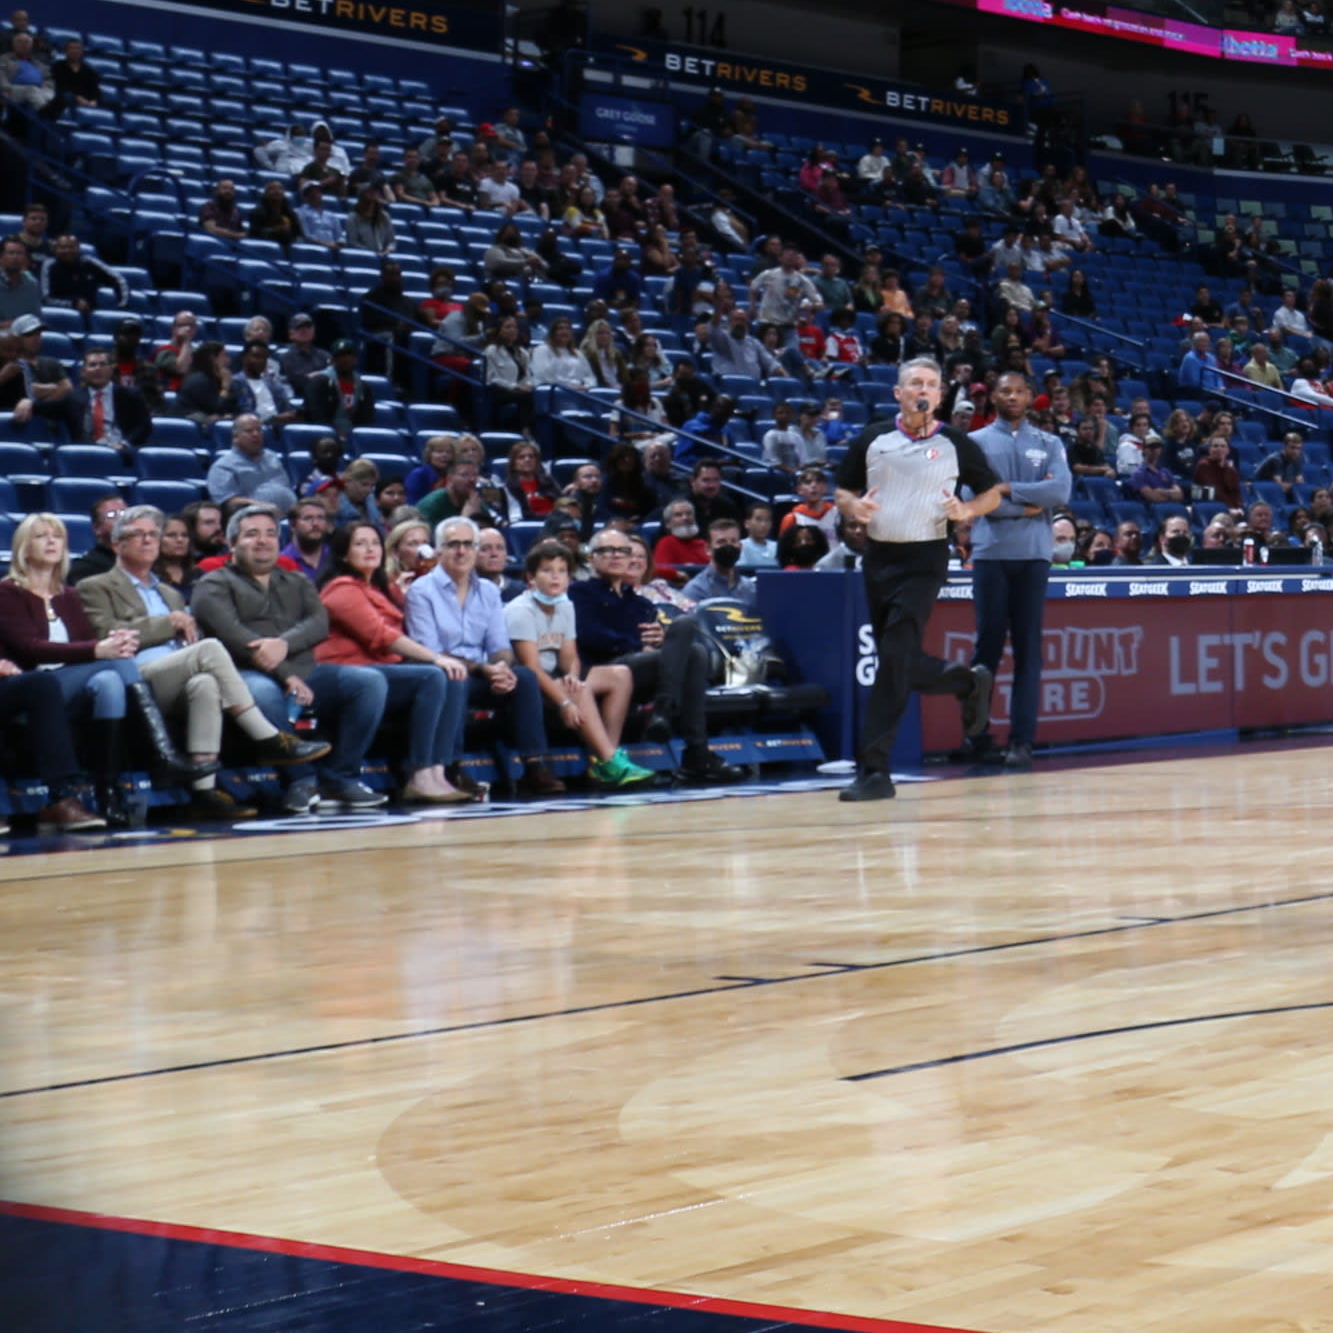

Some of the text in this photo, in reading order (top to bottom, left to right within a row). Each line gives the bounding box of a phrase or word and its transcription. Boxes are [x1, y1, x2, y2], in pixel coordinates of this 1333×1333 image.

[665, 52, 808, 92] BETRIVERS
[885, 90, 1010, 126] BETRIVERS
[1065, 583, 1107, 597] SEATGEEK
[1128, 582, 1169, 596] SEATGEEK
[1189, 580, 1228, 595] SEATGEEK
[1247, 580, 1284, 593] SEATGEEK
[945, 625, 1143, 676] DOUNT
[1169, 630, 1289, 695] LET'S
[998, 680, 1091, 713] TRE
